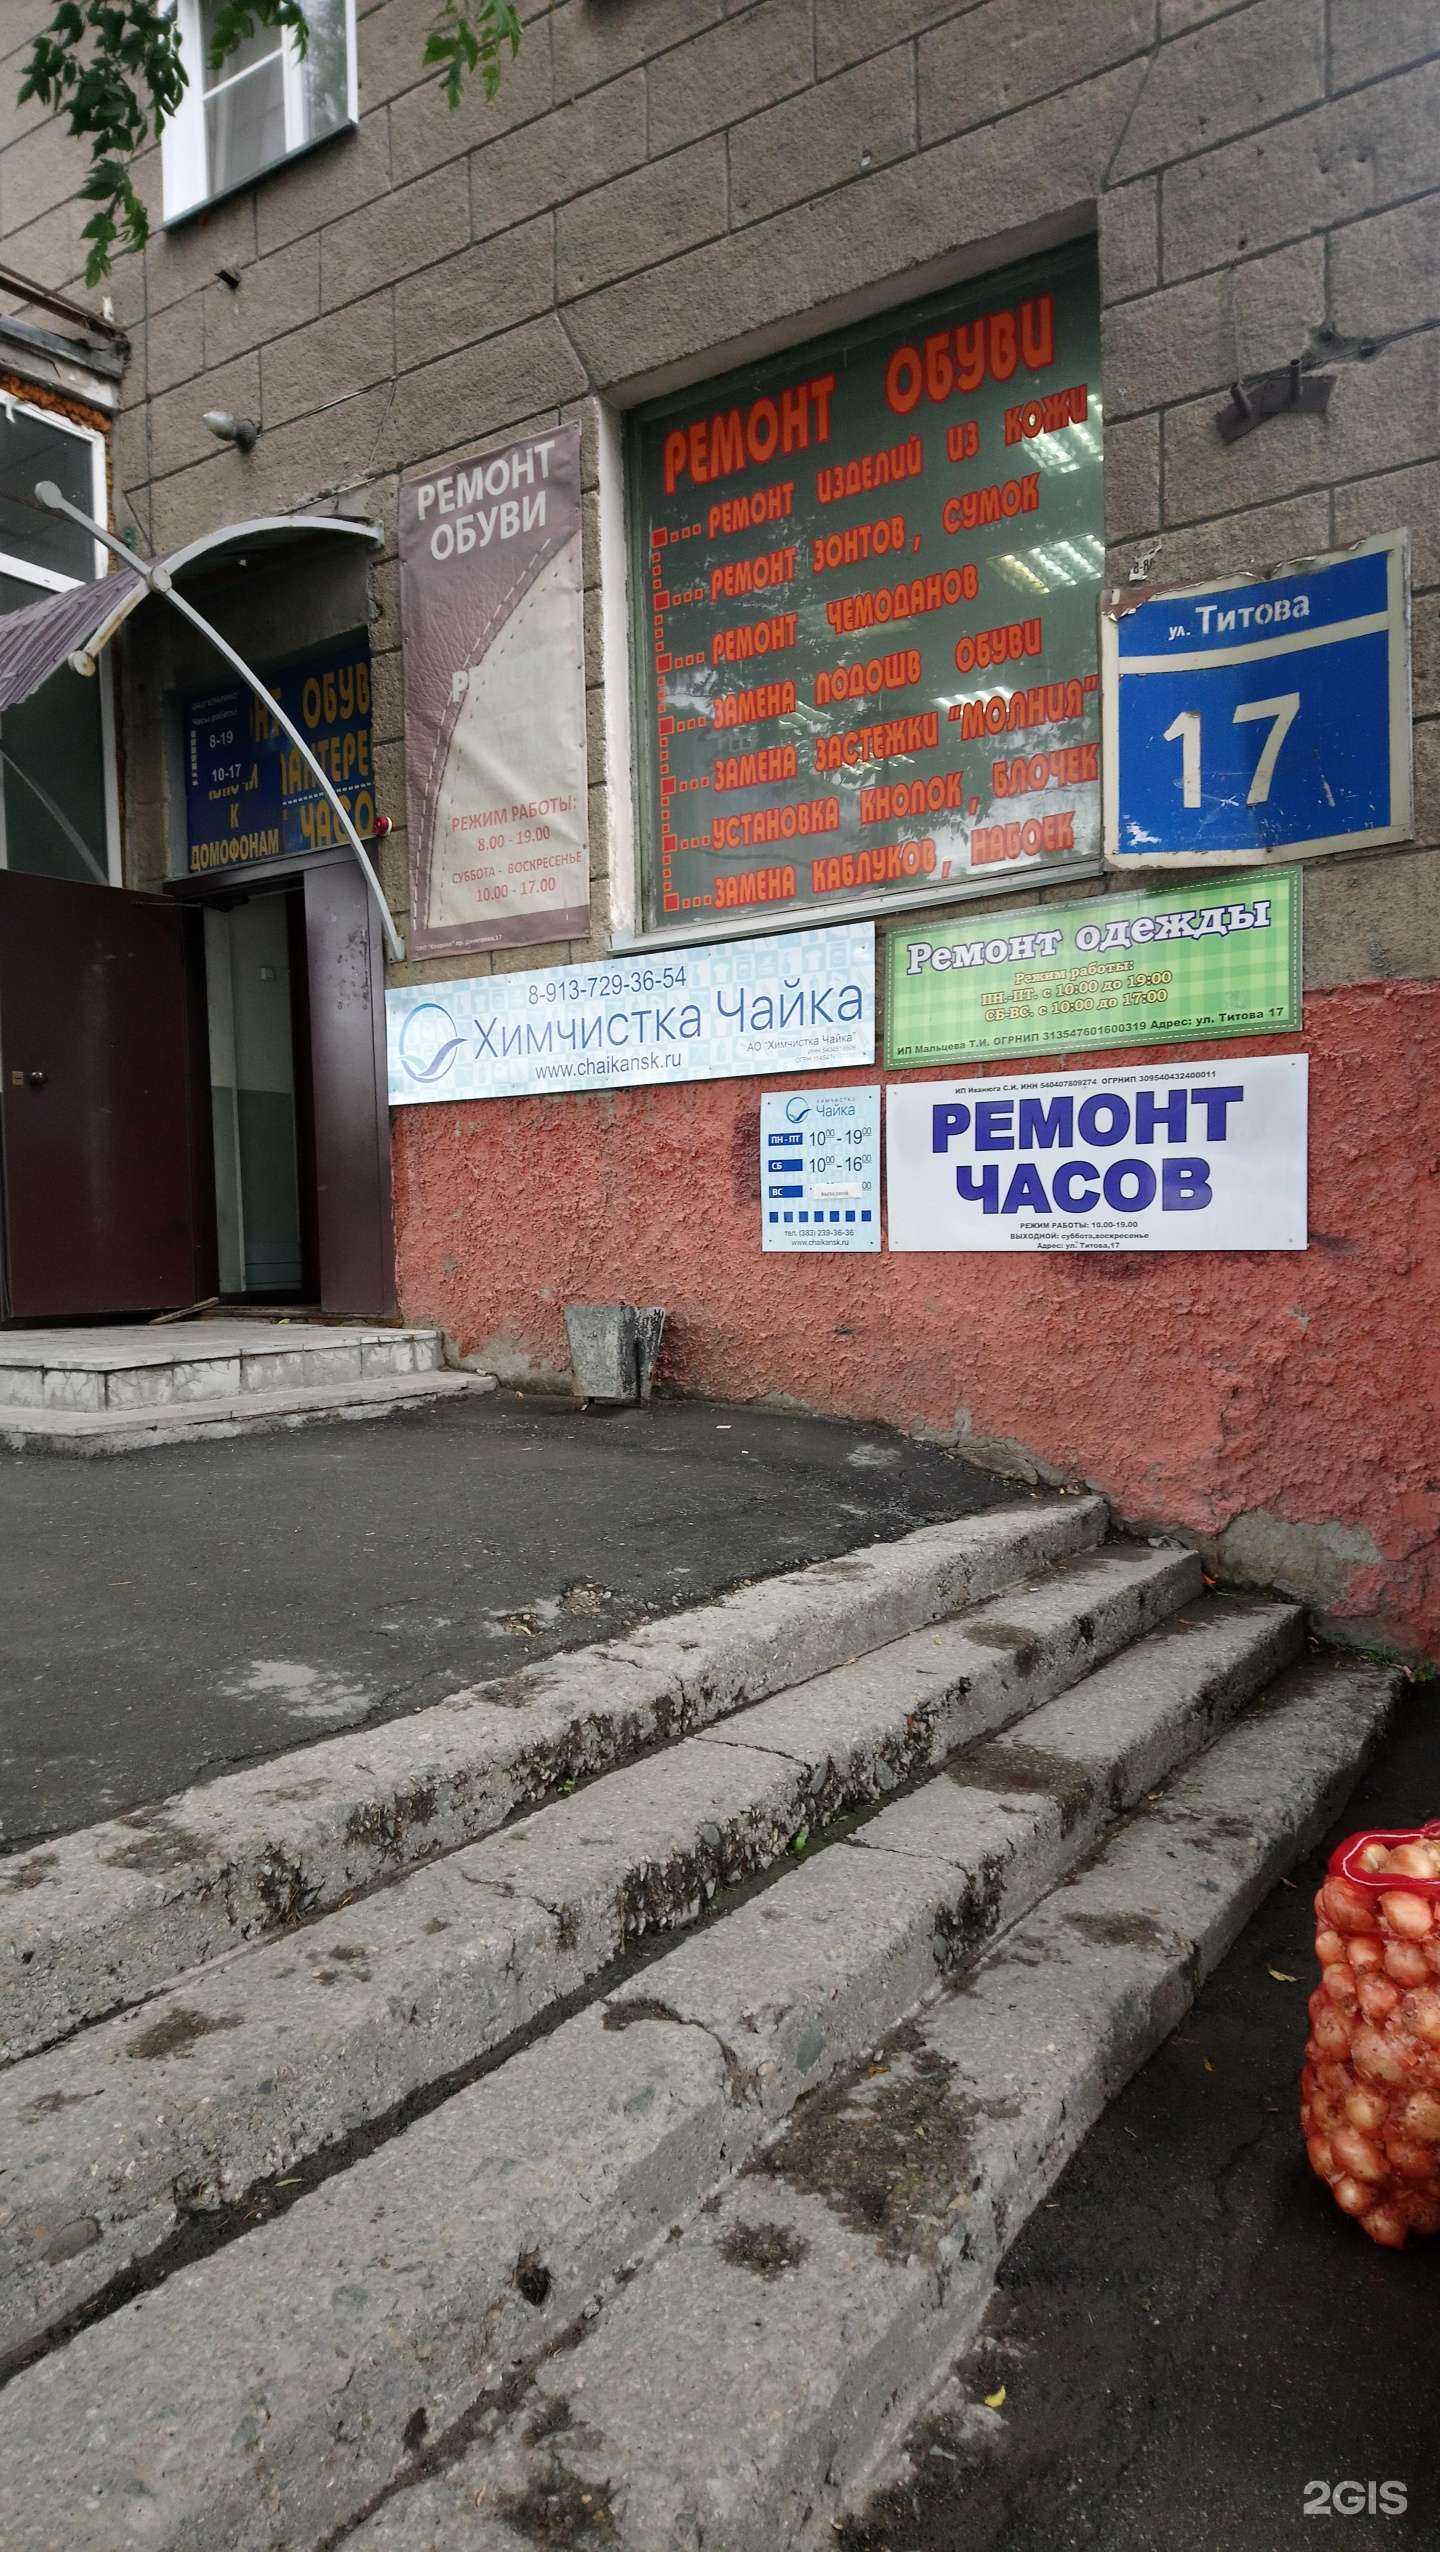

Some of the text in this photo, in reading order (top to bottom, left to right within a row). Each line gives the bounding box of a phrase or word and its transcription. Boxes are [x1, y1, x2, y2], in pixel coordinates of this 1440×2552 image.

[663, 295, 1054, 494] РЕМОНТ ОБУВИ
[417, 440, 556, 521] РЕМОНТ
[707, 385, 1088, 538] РЕМОНТ ИЗДЕЛИЙ ИЗ КОЖИ
[430, 490, 546, 562] ОБУВИ
[710, 548, 796, 600] РЕМОНТ
[942, 473, 1040, 534] СУМОК
[712, 564, 978, 666] РЕМОНТ ЧЕМОДАНОВ
[1168, 594, 1311, 641] ул. Титова
[713, 618, 1042, 730] ЗАМЕНА ПОДОШВ ОБУВИ
[209, 730, 234, 748] 8-19
[714, 674, 1099, 792] ЗАМЕНА ЗАСТЕЖКИ "МОЛНИЯ"
[1163, 691, 1301, 809] 17
[212, 763, 242, 783] 10-17
[229, 803, 239, 828] К
[451, 795, 577, 832] РЕЖИМ РАБОТЫ:
[712, 798, 840, 850] УСТАНОВКА
[991, 742, 1100, 797] БЛОЧЕК
[191, 828, 280, 871] ДОМОФОНАМ
[478, 835, 505, 851] 8.00
[516, 825, 551, 845] 19.00
[452, 867, 496, 884] СУББОТА
[508, 851, 583, 874] ВОСКРЕСЕНЬЕ
[714, 866, 796, 908] ЗАМЕНА
[971, 812, 1075, 866] НАБОЕК
[477, 884, 509, 902] 10.00
[520, 877, 556, 895] 17.00
[907, 900, 1272, 976] Ремонт одежды
[528, 966, 688, 1005] 8-913-729-36-54
[1014, 961, 1134, 986] Режим работы:
[1055, 978, 1099, 997] 10:00
[1103, 977, 1122, 990] до
[1127, 970, 1172, 987] 19:00
[474, 978, 864, 1060] Химчистка Чайка
[1051, 996, 1095, 1013] 10:00
[1099, 993, 1119, 1009] до
[1123, 988, 1168, 1005] 17:00
[897, 1046, 913, 1056] ИП
[968, 1036, 990, 1049] Т.И.
[993, 1031, 1040, 1046] ОГРНИП
[1150, 1015, 1193, 1032] Адрес:
[1195, 1013, 1215, 1027] ул.
[1218, 1008, 1264, 1025] Титова
[1268, 1006, 1285, 1019] 17
[535, 1053, 682, 1081] www.chaikansk.ru
[1101, 1076, 1137, 1086] ОГРНИП
[816, 1104, 856, 1118] Чайка
[932, 1086, 1243, 1153] РЕМОНТ
[956, 1157, 1212, 1215] ЧАСОВ
[1010, 1231, 1059, 1241] ВЫХОДНОЙ:
[1020, 1221, 1049, 1230] РЕЖИМ
[1052, 1221, 1089, 1230] РАБОТЫ:
[1037, 1242, 1064, 1250] Адрес:
